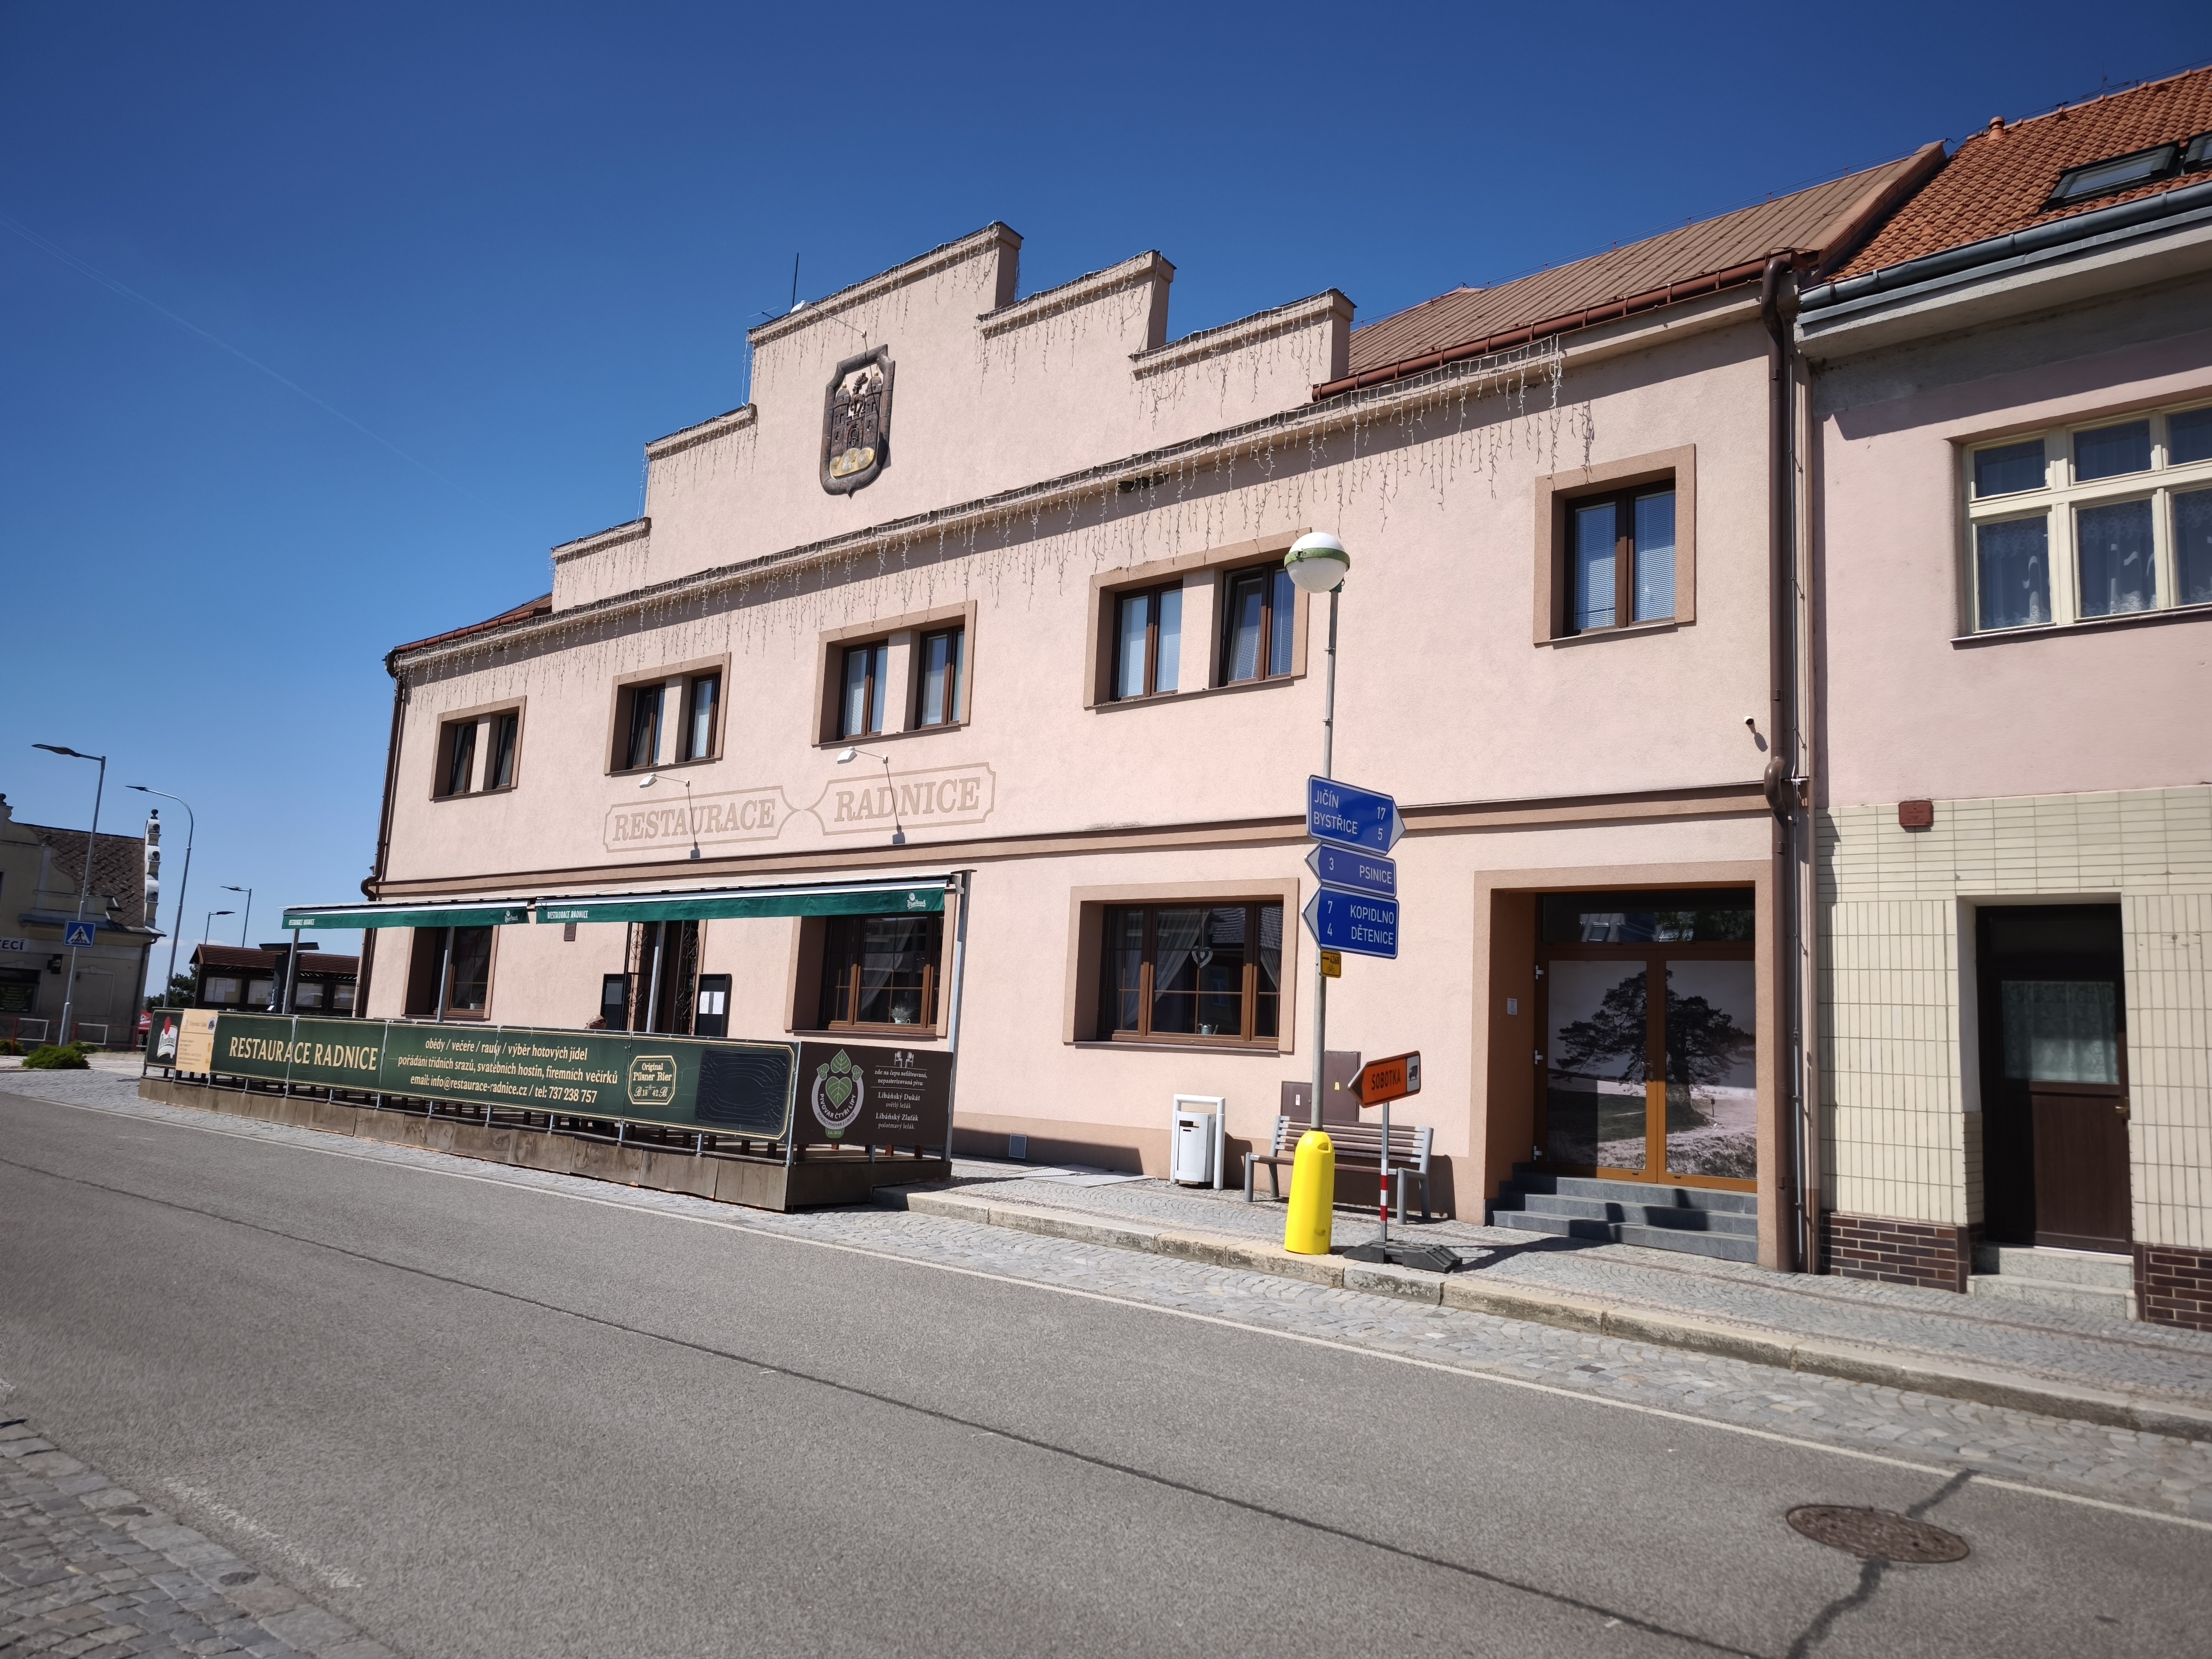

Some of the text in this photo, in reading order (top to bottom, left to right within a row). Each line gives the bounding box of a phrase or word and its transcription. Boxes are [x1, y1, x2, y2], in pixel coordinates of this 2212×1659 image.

[612, 777, 981, 841] RESTAURACE RADNICE
[1314, 789, 1386, 820] JIČÍN 17
[1314, 811, 1383, 841] BYSTŘICE 5
[1329, 857, 1392, 884] 3 PSINICE
[547, 910, 588, 919] RESTAURACE RADNICE
[1327, 901, 1394, 924] 7 KOPIDLNO
[0, 939, 25, 950] ECÍ
[1327, 923, 1394, 945] 4 DĚTENICE
[1330, 955, 1340, 965] 4368
[229, 1036, 378, 1070] RESTAURACE RADNICE
[426, 1038, 446, 1052] obědy
[452, 1040, 475, 1052] večeře
[481, 1043, 501, 1056] rauty
[508, 1043, 531, 1057] výběr
[531, 1044, 568, 1061] hotových
[569, 1046, 588, 1062] jídel
[397, 1055, 618, 1084] pořádání třídních srazů, svatebních hostin, firemních večírků
[633, 1072, 672, 1081] Pilsner Bier
[642, 1063, 663, 1072] Original
[410, 1074, 430, 1085] email:
[430, 1075, 528, 1096] info@restaurace-radnice.cz
[535, 1085, 548, 1098] tel:
[549, 1086, 563, 1100] 737
[563, 1087, 579, 1102] 238
[581, 1089, 597, 1103] 757
[1372, 1068, 1401, 1090] SOBOTKA
[820, 1094, 834, 1119] PIVOVAR
[835, 1108, 850, 1119] ČTYŘI
[878, 1091, 903, 1101] Libáňský
[875, 1112, 919, 1122] Libáňský Zlaťák
[878, 1122, 902, 1130] polotmavý
